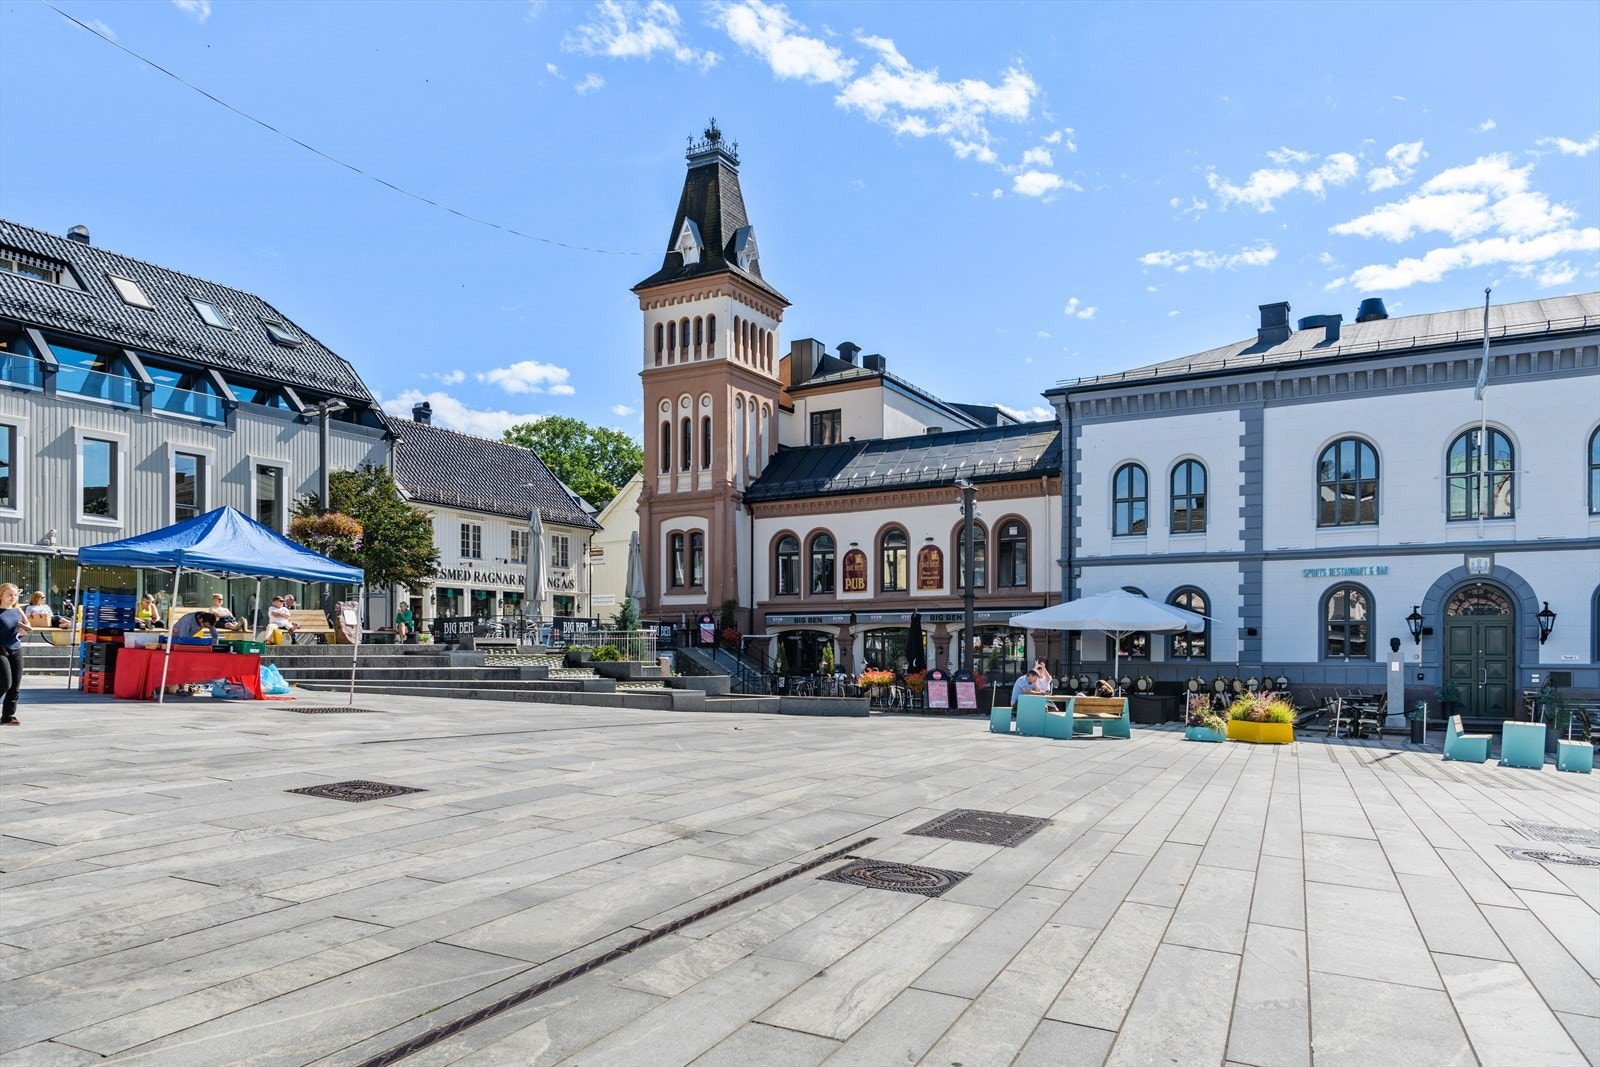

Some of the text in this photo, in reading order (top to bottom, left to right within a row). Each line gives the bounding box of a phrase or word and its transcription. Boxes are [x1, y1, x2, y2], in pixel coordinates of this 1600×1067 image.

[1303, 568, 1327, 577] SPORTS
[1329, 567, 1368, 577] RESTAURANT
[1376, 566, 1389, 575] BAR
[474, 571, 516, 585] RAGNAR
[561, 579, 575, 589] A/S
[845, 578, 865, 590] PUB
[443, 621, 474, 635] BIG BEN
[562, 621, 589, 634] BIG BEN
